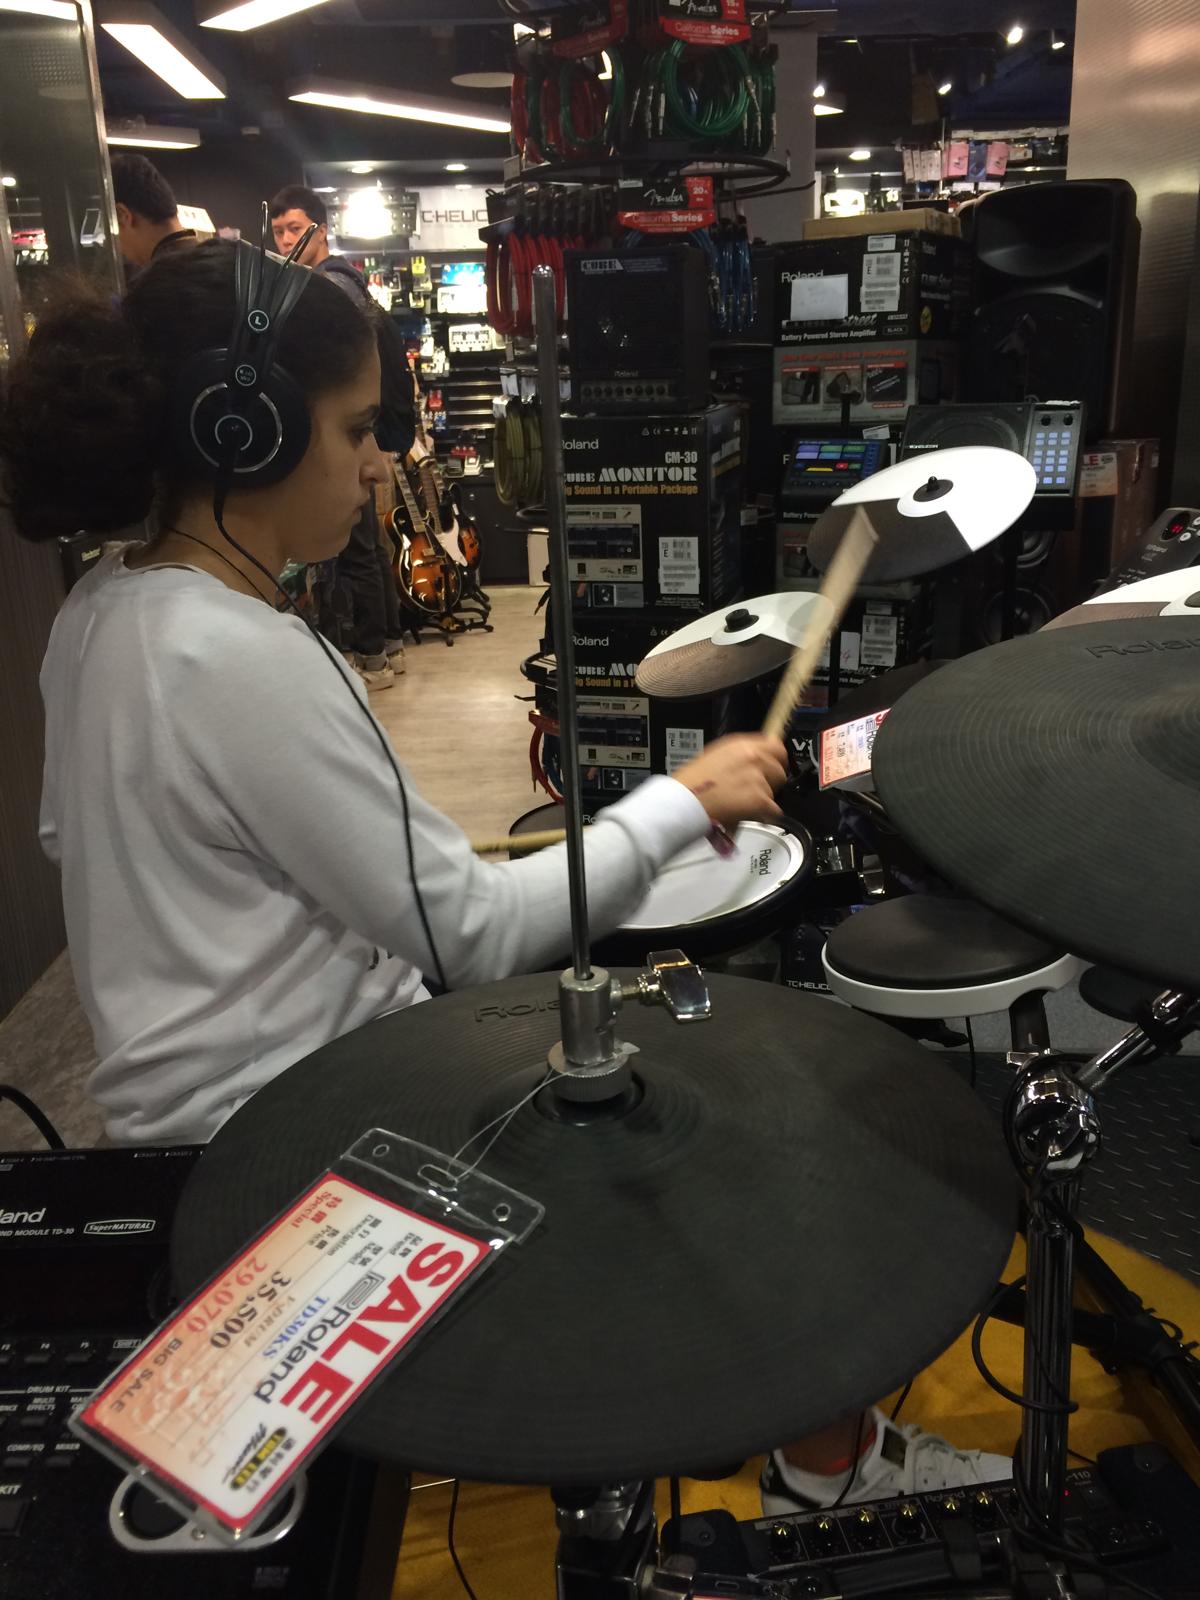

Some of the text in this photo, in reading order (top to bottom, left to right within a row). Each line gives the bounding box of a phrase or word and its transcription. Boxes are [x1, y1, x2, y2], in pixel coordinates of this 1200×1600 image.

[710, 24, 740, 36] Series
[643, 188, 684, 206] Fender
[671, 213, 703, 223] Series
[781, 333, 803, 342] Battery
[803, 331, 829, 341] Powered
[849, 329, 878, 338] Amplifier
[664, 451, 698, 464] CM-30
[598, 466, 698, 483] MONITOR
[574, 485, 602, 496] Sound
[603, 485, 612, 495] in
[614, 487, 621, 495] a
[622, 485, 659, 495] Portable
[660, 484, 699, 496] Package
[586, 678, 611, 688] Sound
[759, 848, 772, 876] Roland
[290, 1191, 332, 1229] Special
[14, 1228, 50, 1236] MODULE
[88, 1221, 152, 1232] SuperNATURAL
[307, 1224, 332, 1247] Price
[327, 1214, 374, 1258] Description
[348, 1241, 376, 1265] Model
[183, 1256, 269, 1335] 29,070
[207, 1270, 291, 1352] 35,500
[260, 1293, 328, 1361] TD30KS
[279, 1241, 465, 1424] SALE
[252, 1305, 349, 1405] Roland
[109, 1336, 183, 1414] BIG SALE
[26, 1385, 55, 1393] DRUM
